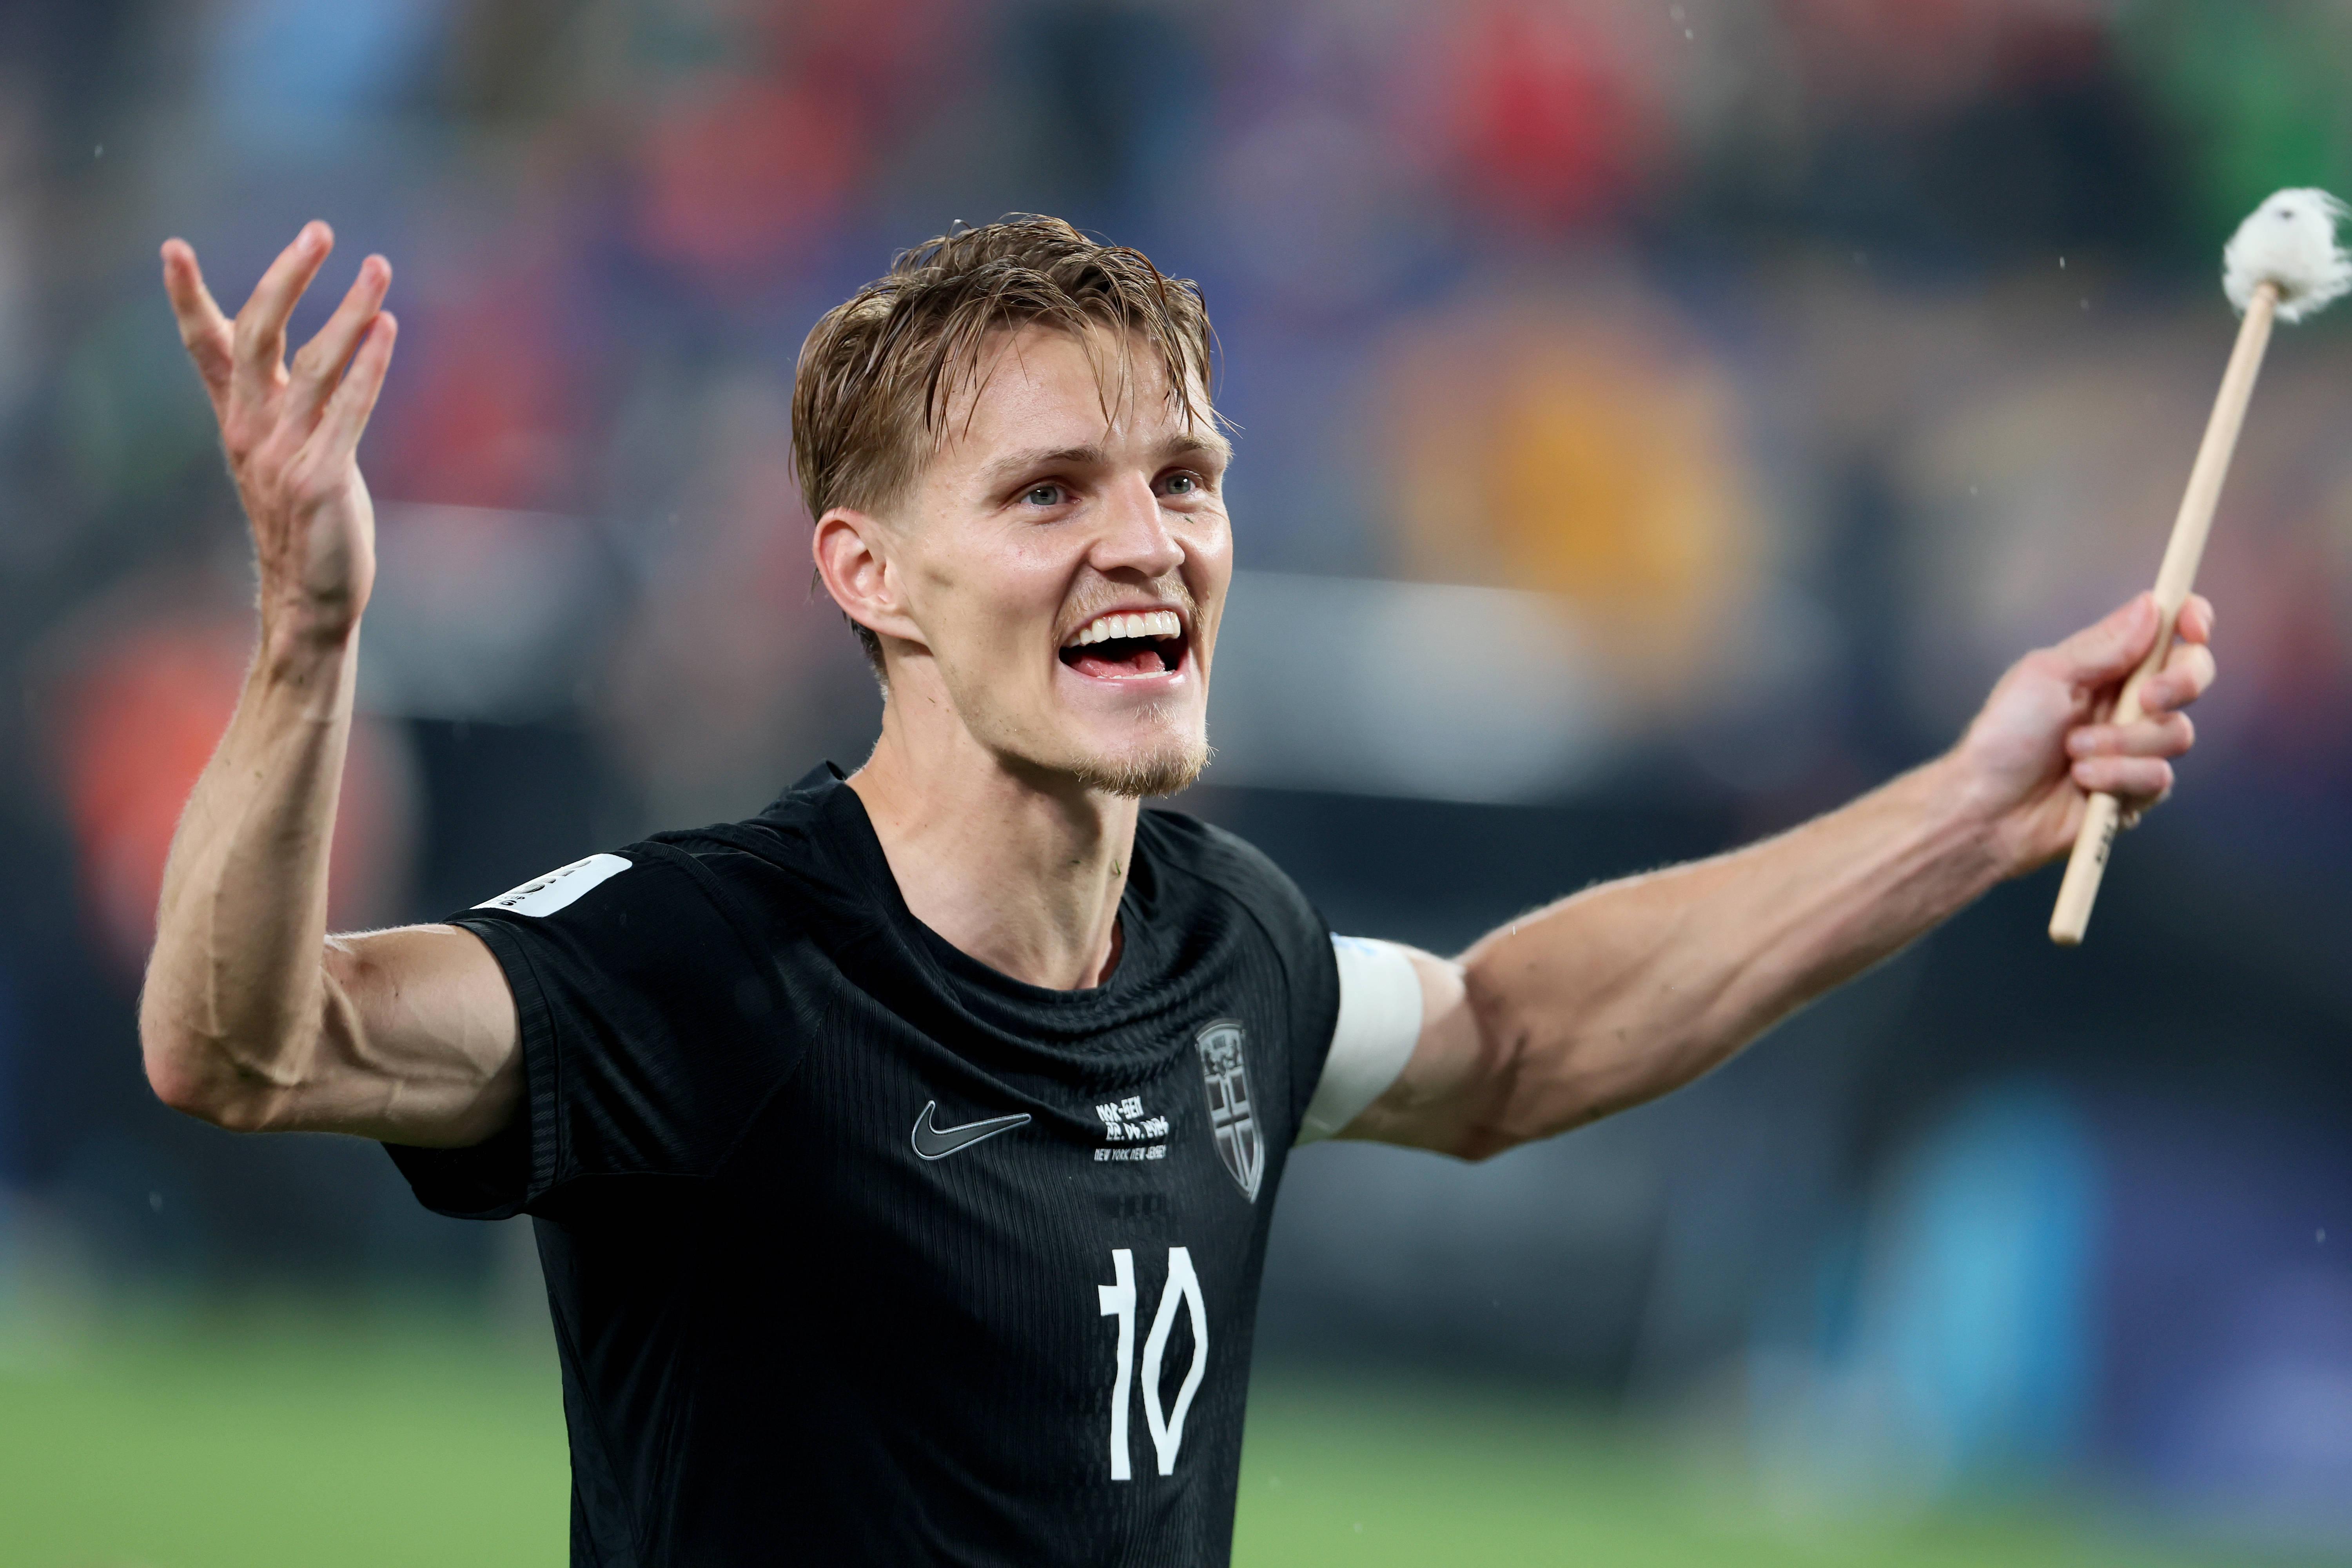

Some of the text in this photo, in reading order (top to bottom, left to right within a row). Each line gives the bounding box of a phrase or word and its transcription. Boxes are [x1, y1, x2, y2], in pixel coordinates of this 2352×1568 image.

[1096, 1096, 1144, 1122] NOR-SEN
[1094, 1145, 1166, 1161] NEW YORK NEW JERSEY
[1098, 1247, 1208, 1480] 10
